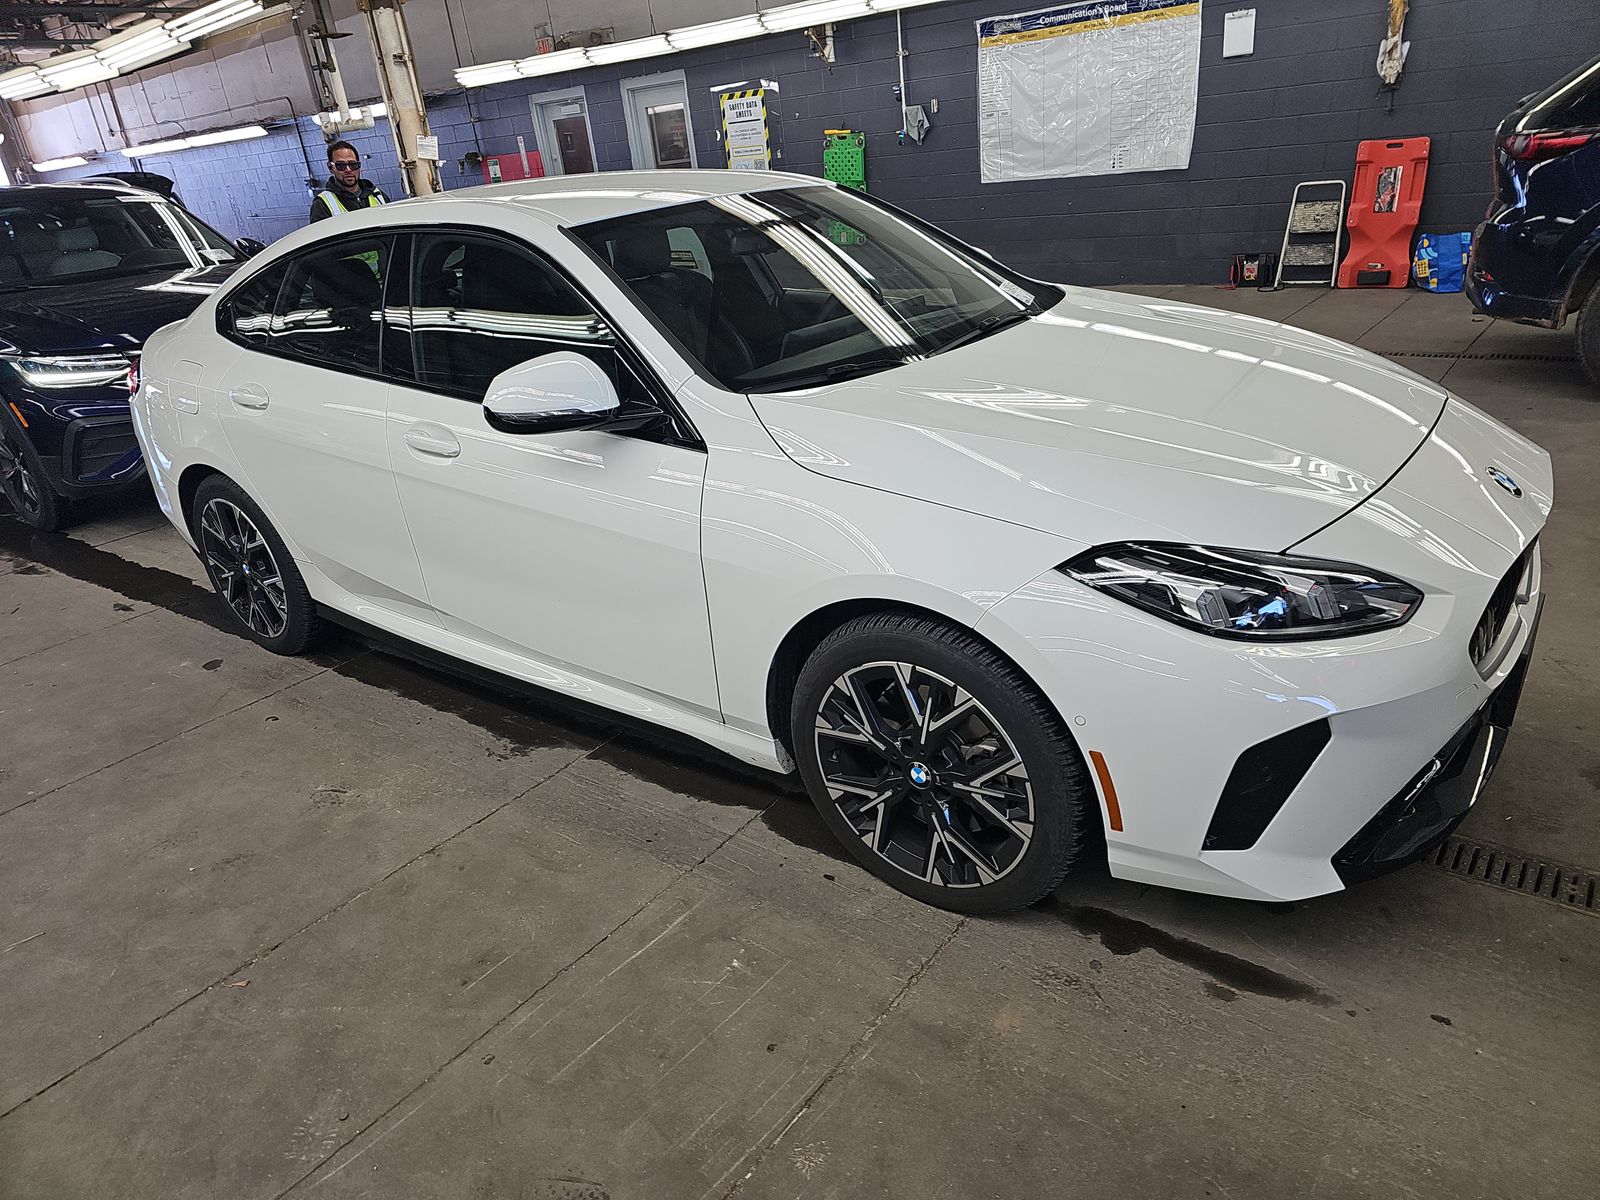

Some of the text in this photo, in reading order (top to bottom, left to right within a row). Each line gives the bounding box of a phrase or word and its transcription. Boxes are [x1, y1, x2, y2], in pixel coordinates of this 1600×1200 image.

[1039, 6, 1103, 24] Communication's
[1104, 2, 1128, 13] Board
[728, 103, 745, 111] SAFETY
[735, 110, 752, 118] SHEETS
